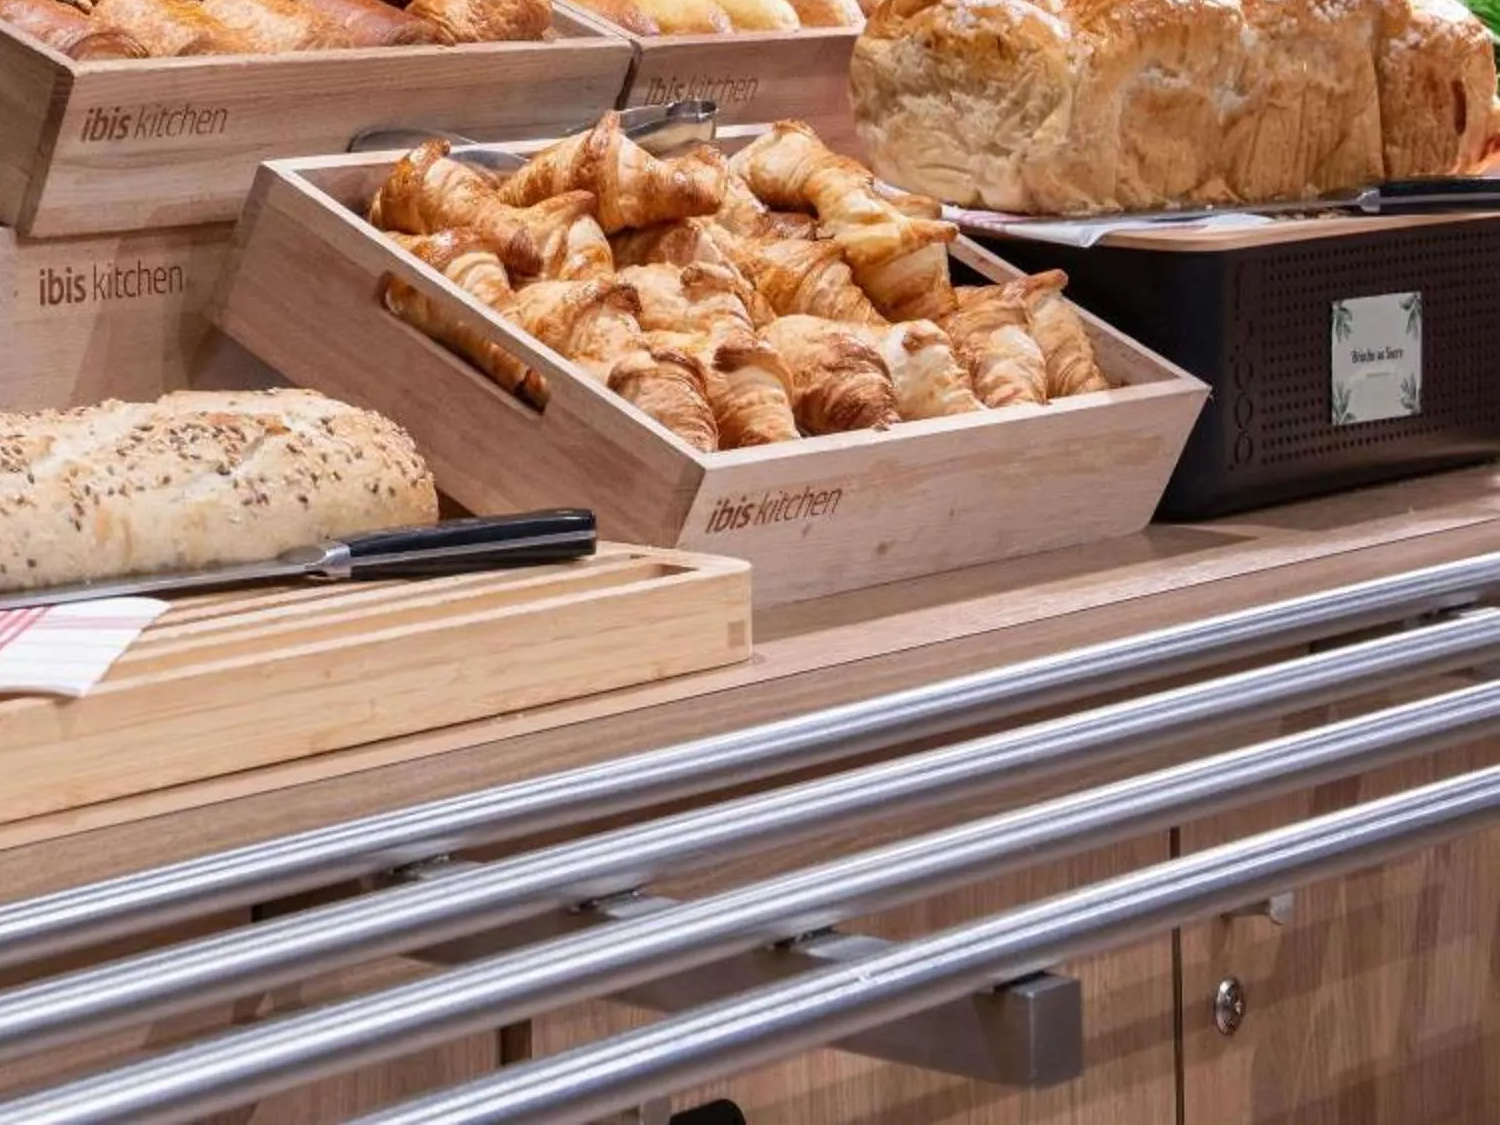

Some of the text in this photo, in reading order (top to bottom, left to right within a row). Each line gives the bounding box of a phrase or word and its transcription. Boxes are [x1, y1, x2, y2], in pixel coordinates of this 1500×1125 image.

[644, 75, 685, 106] ibis
[81, 103, 228, 142] ibis kitchen
[38, 259, 183, 306] ibis kitchen
[705, 485, 843, 534] ibis kitchen
